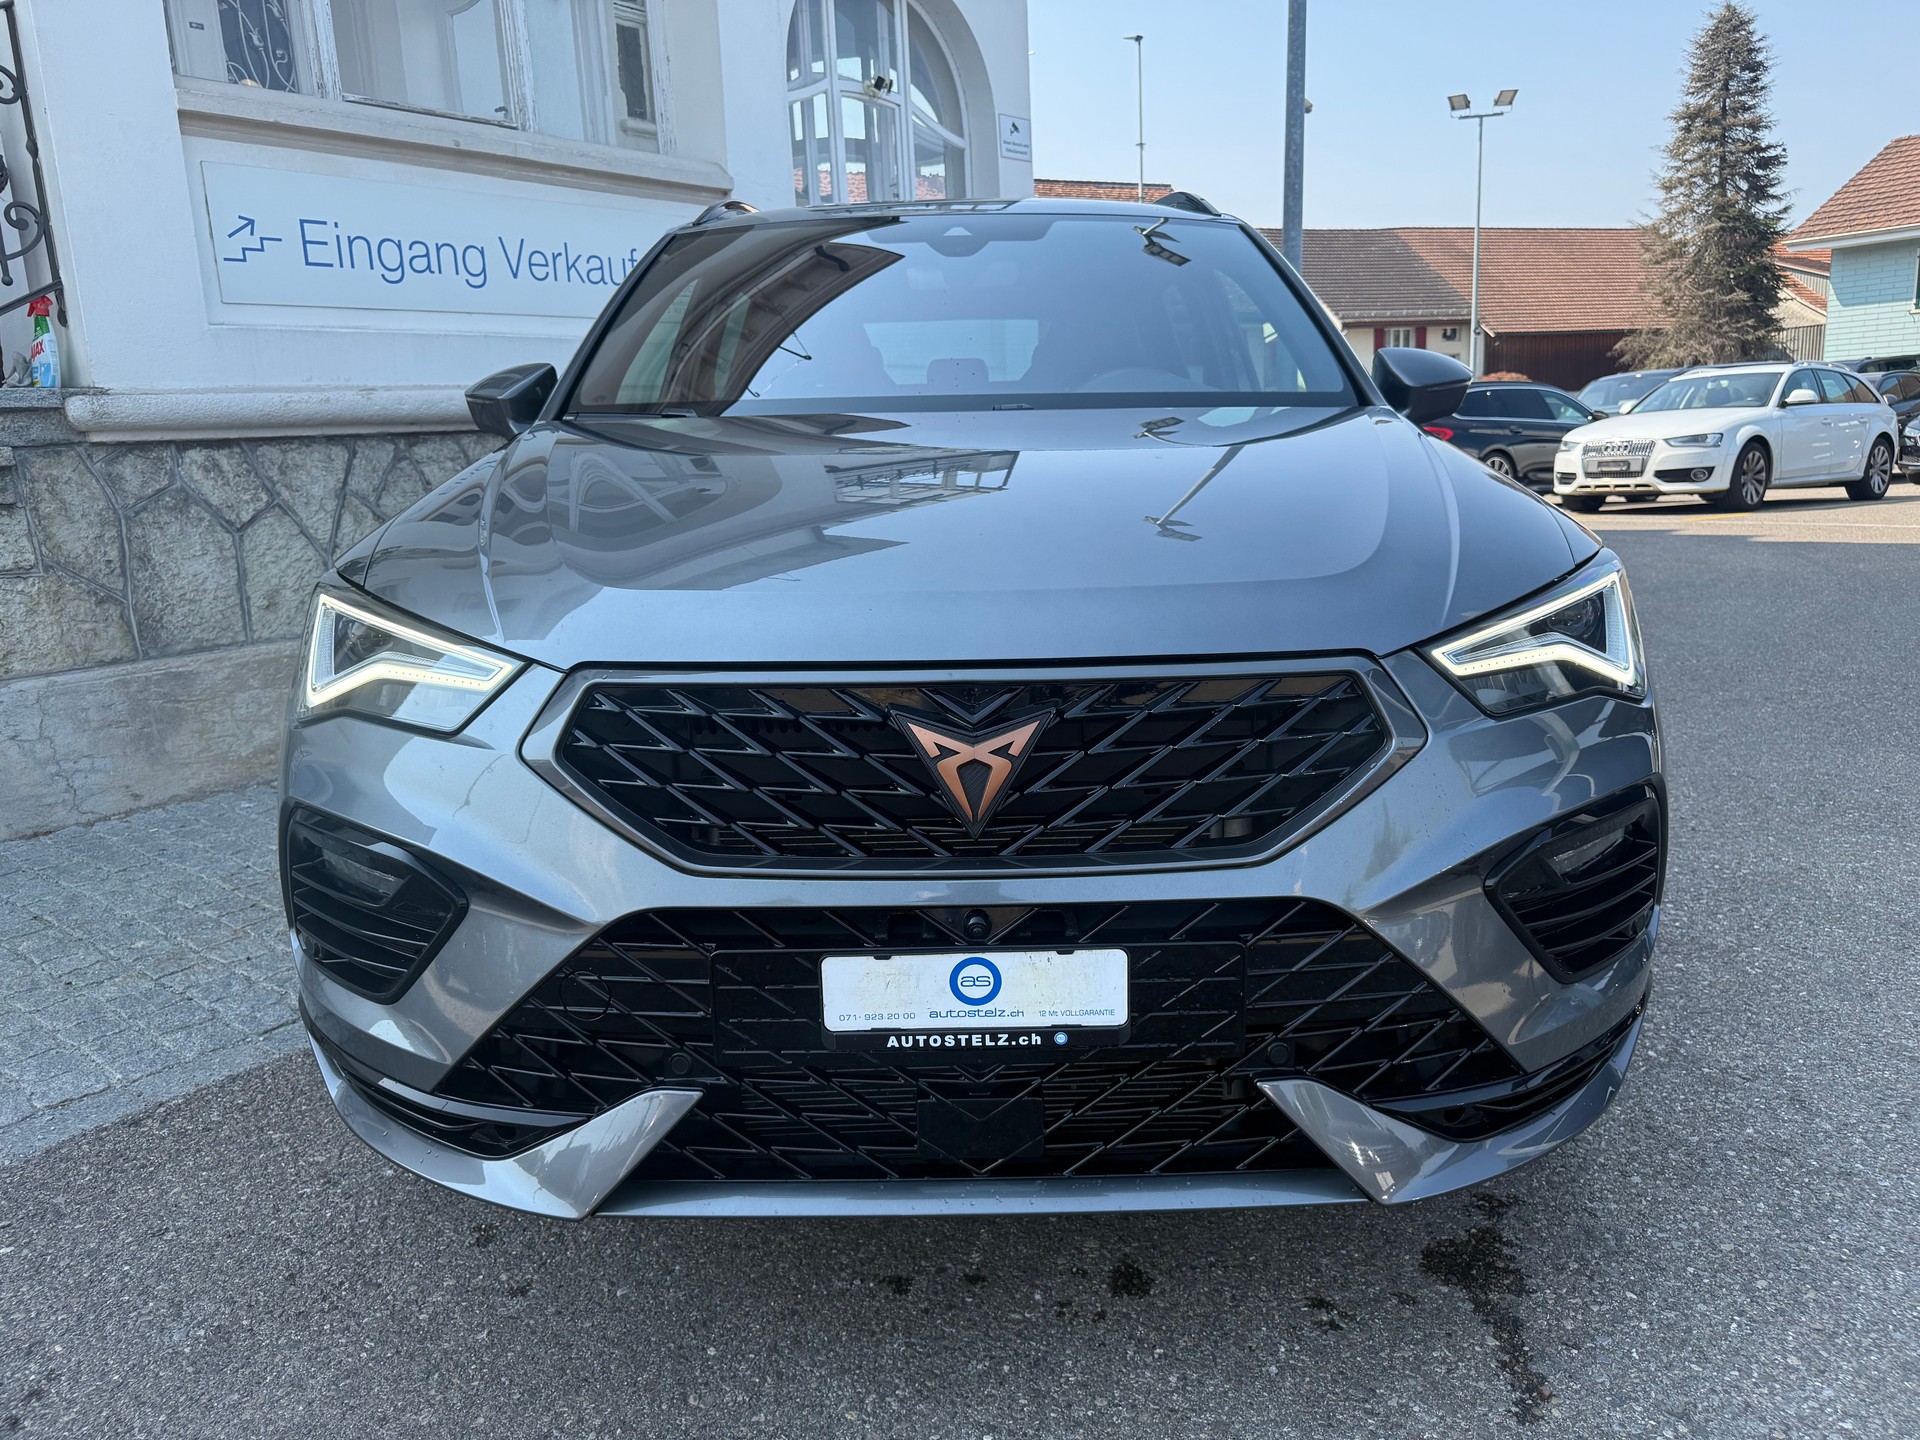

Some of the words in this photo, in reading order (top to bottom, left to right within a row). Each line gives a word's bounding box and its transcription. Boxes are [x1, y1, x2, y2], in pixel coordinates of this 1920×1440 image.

[298, 218, 488, 289] Eingang
[498, 236, 638, 287] Verkauf
[960, 975, 991, 987] as
[864, 1013, 884, 1021] 923
[887, 1012, 900, 1020] 20
[902, 1012, 916, 1020] 00
[929, 1007, 1025, 1019] autostelz.ch
[1060, 1008, 1116, 1017] VOLLGARANTIE
[886, 1033, 1042, 1048] AUTOSTELZ.ch
